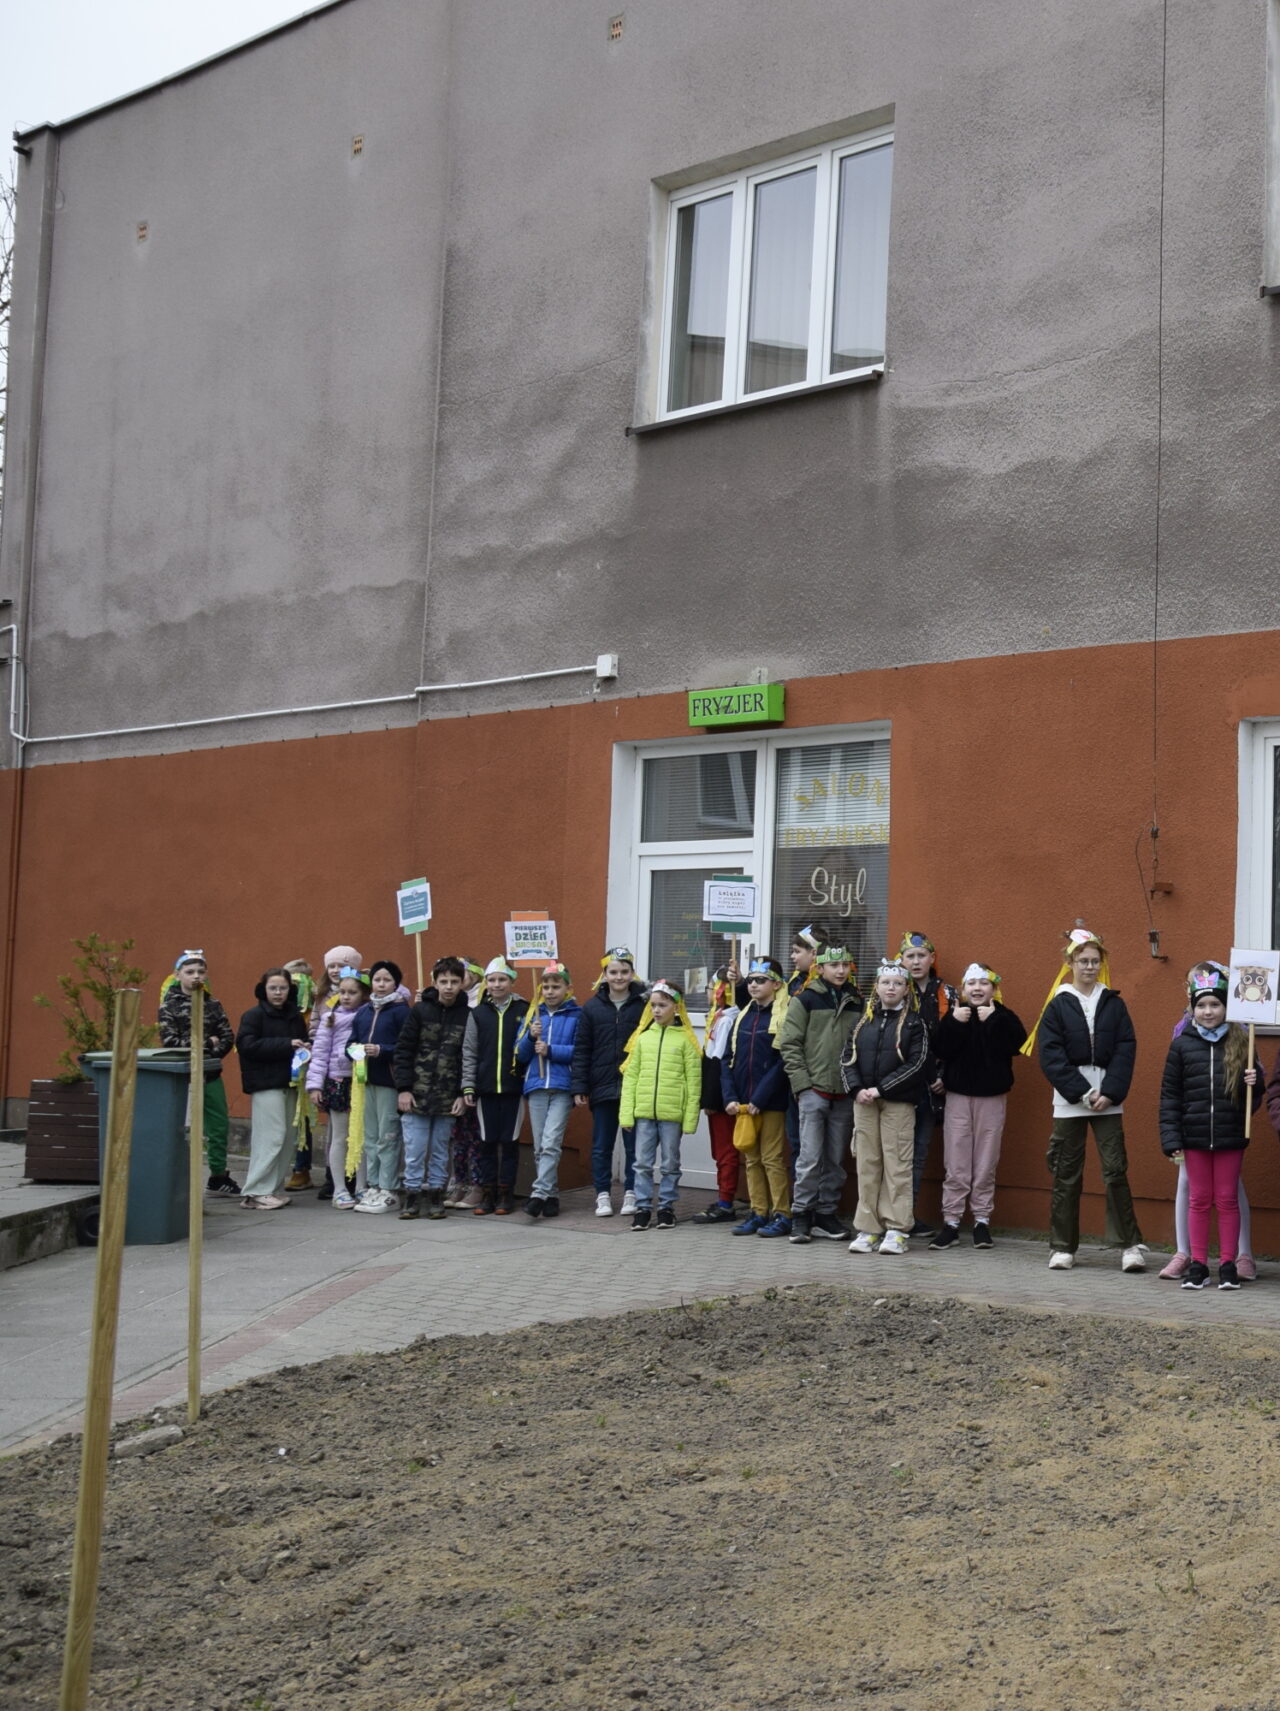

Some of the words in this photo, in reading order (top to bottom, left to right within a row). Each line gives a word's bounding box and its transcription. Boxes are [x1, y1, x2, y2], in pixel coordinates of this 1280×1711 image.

[692, 691, 765, 719] FRYZJER
[784, 824, 890, 848] FRYZJERSK
[808, 866, 867, 918] Styl
